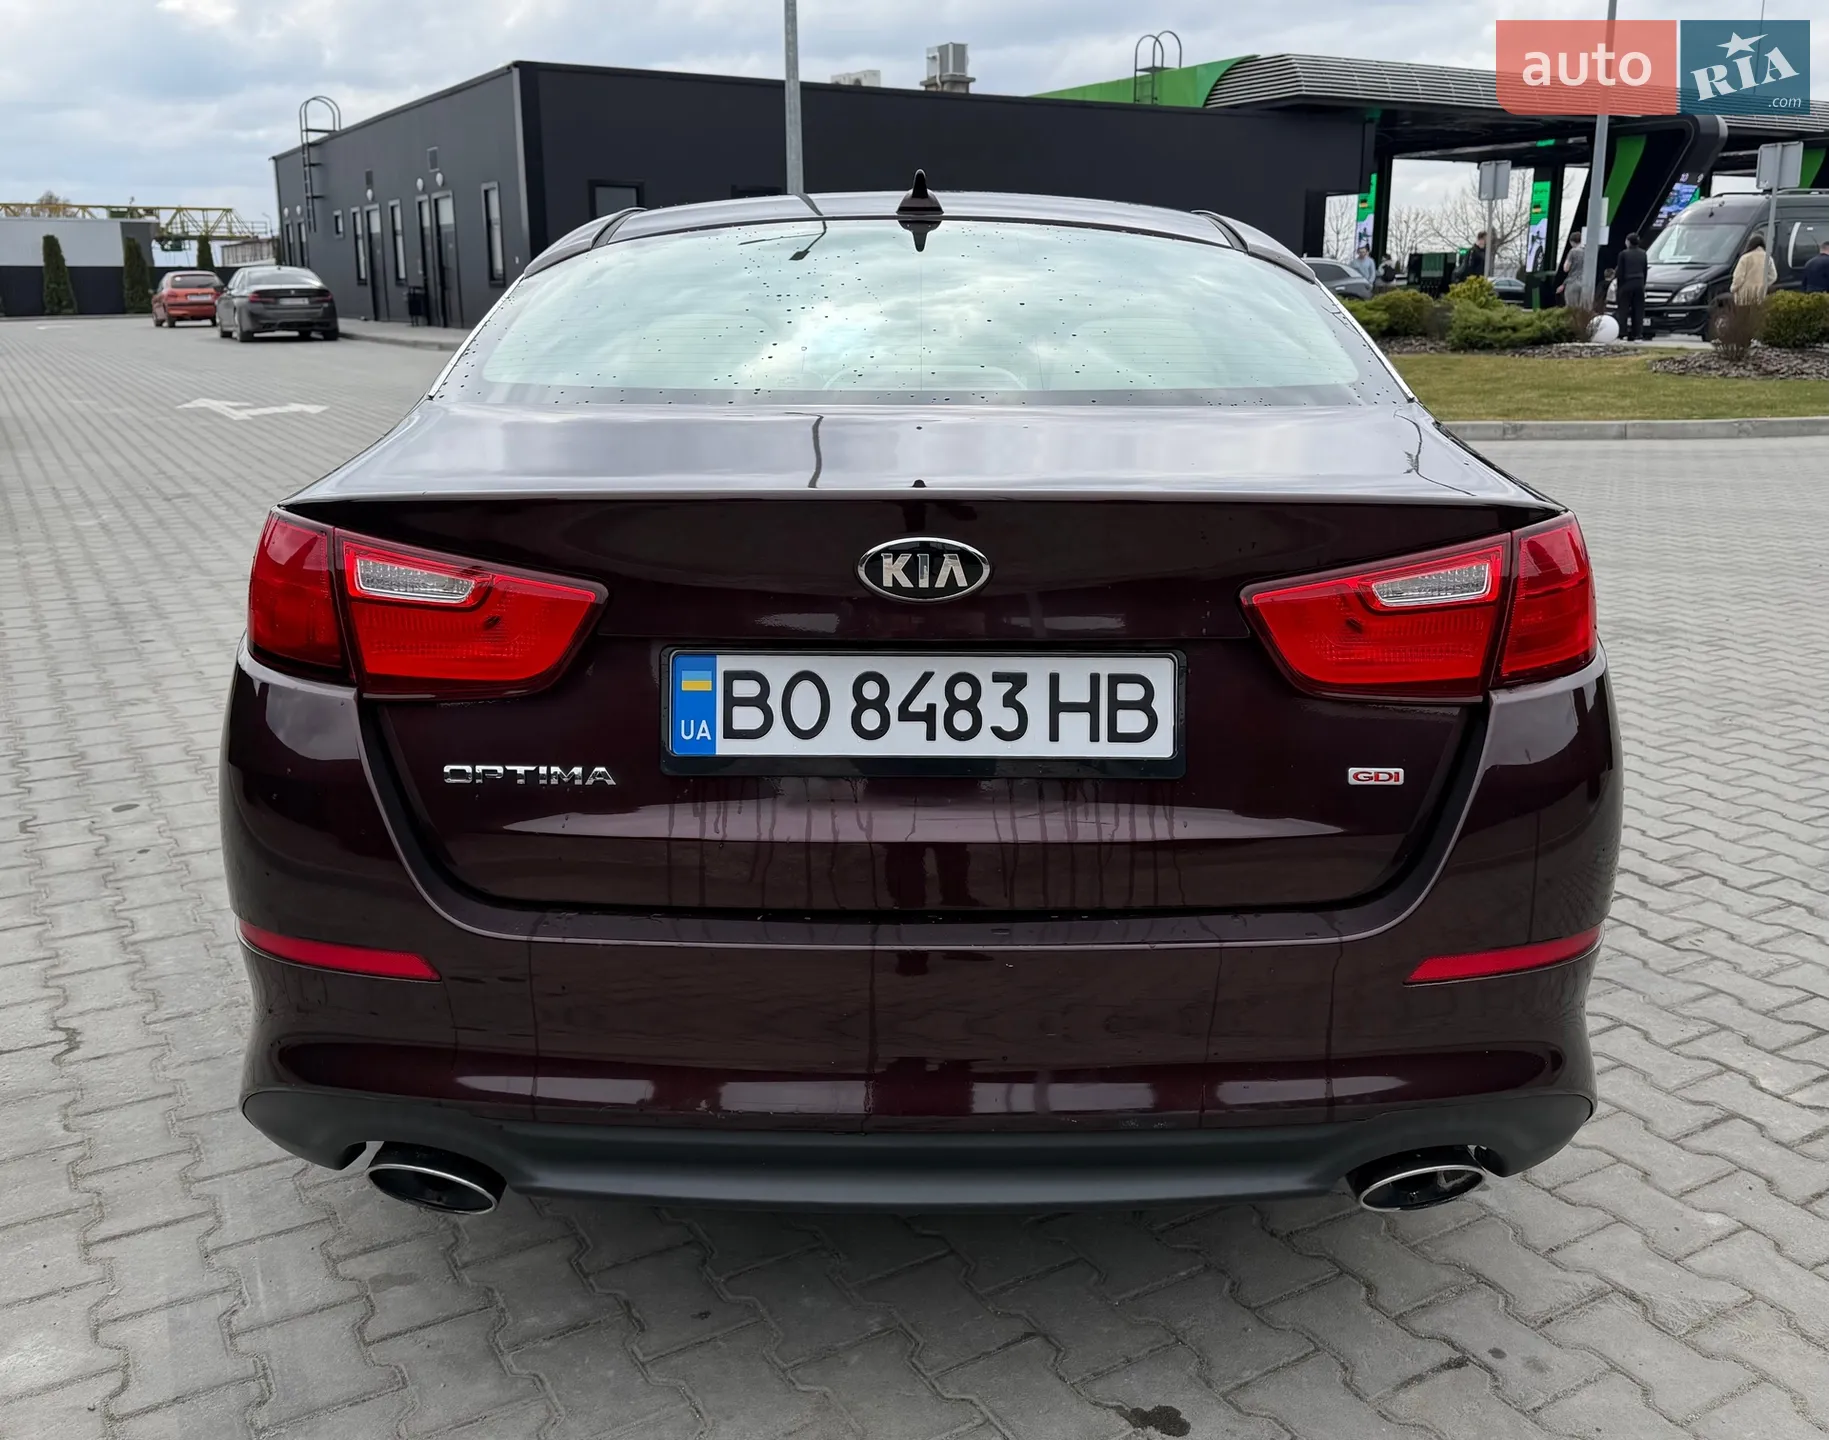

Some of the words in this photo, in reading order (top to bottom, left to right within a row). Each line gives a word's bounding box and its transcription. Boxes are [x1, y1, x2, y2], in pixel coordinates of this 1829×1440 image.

[880, 553, 969, 588] KIA
[723, 670, 831, 740] BO
[850, 670, 1029, 742] 8483
[1048, 671, 1159, 743] HB
[680, 720, 712, 741] UA
[443, 764, 617, 786] OPTIMA
[1352, 771, 1400, 783] GDI
